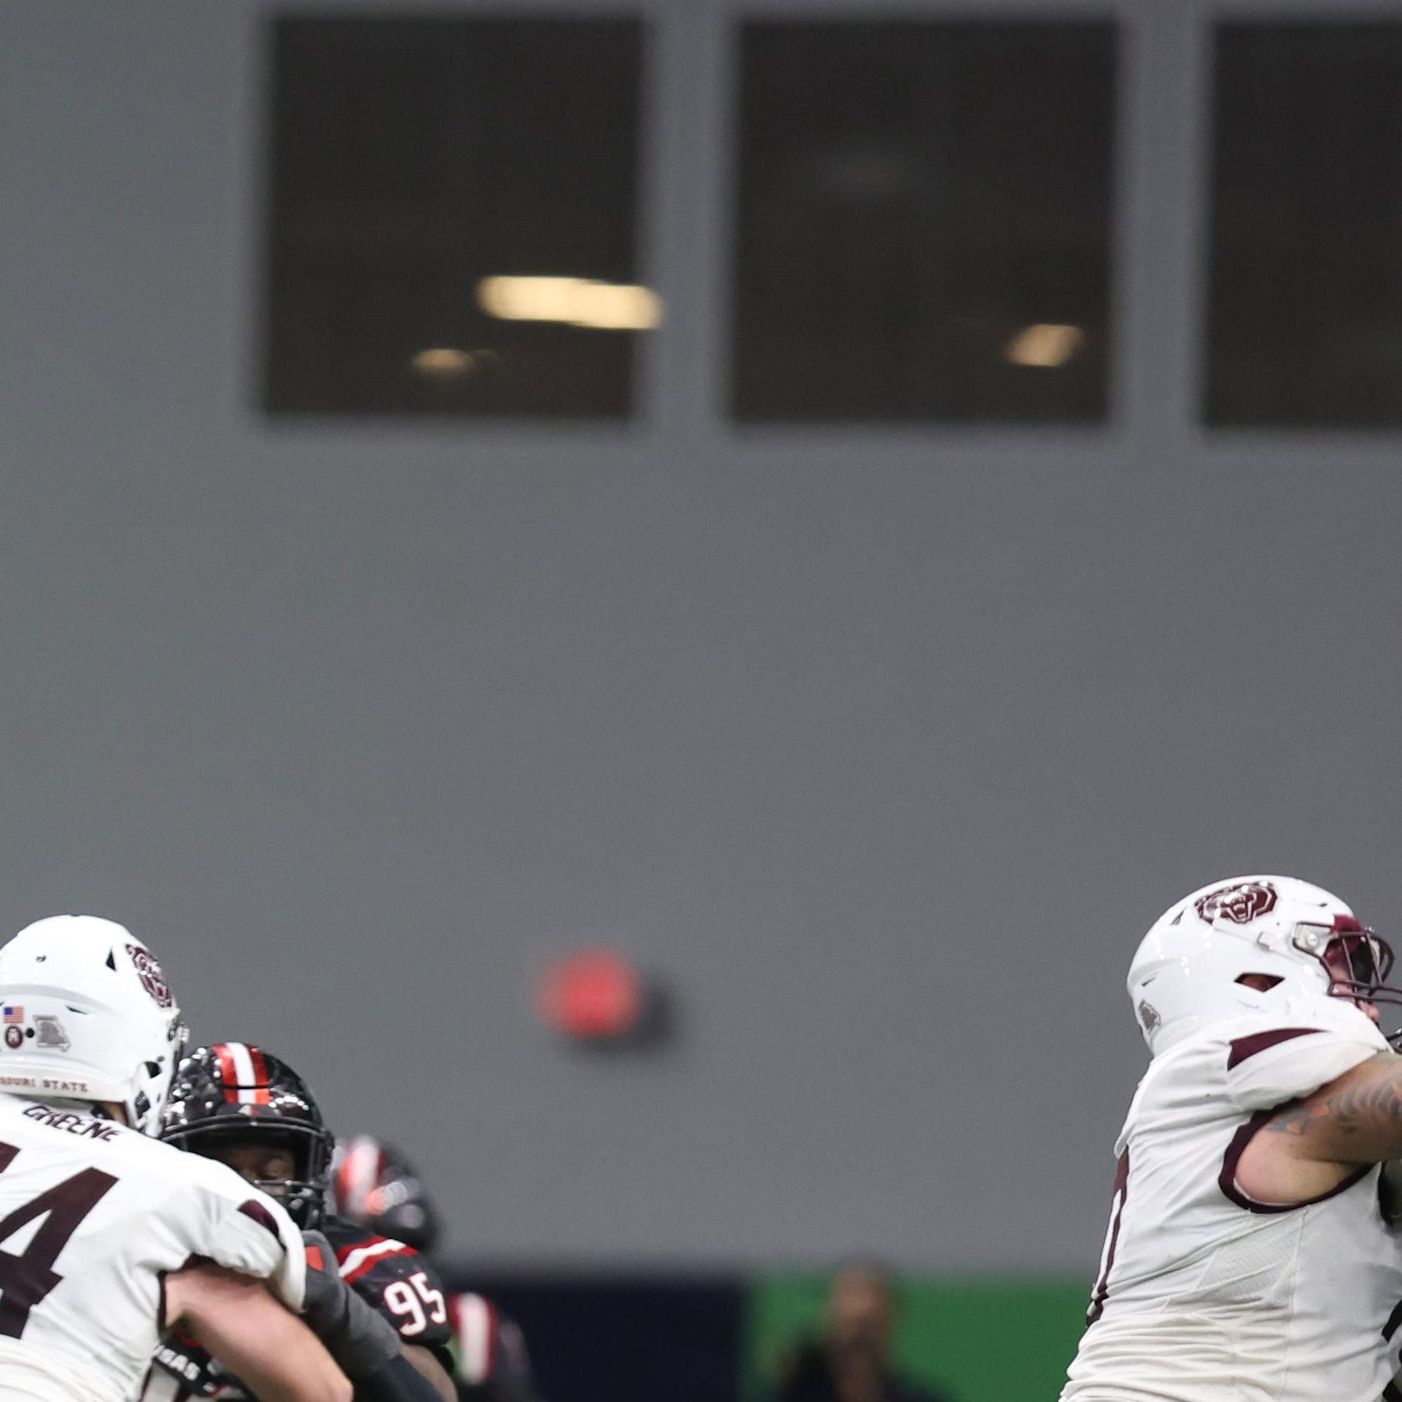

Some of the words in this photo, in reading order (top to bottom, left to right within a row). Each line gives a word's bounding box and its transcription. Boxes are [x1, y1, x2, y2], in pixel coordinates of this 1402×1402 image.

[42, 1079, 88, 1092] STATE
[22, 1104, 119, 1142] GREENE
[382, 1271, 447, 1337] 95
